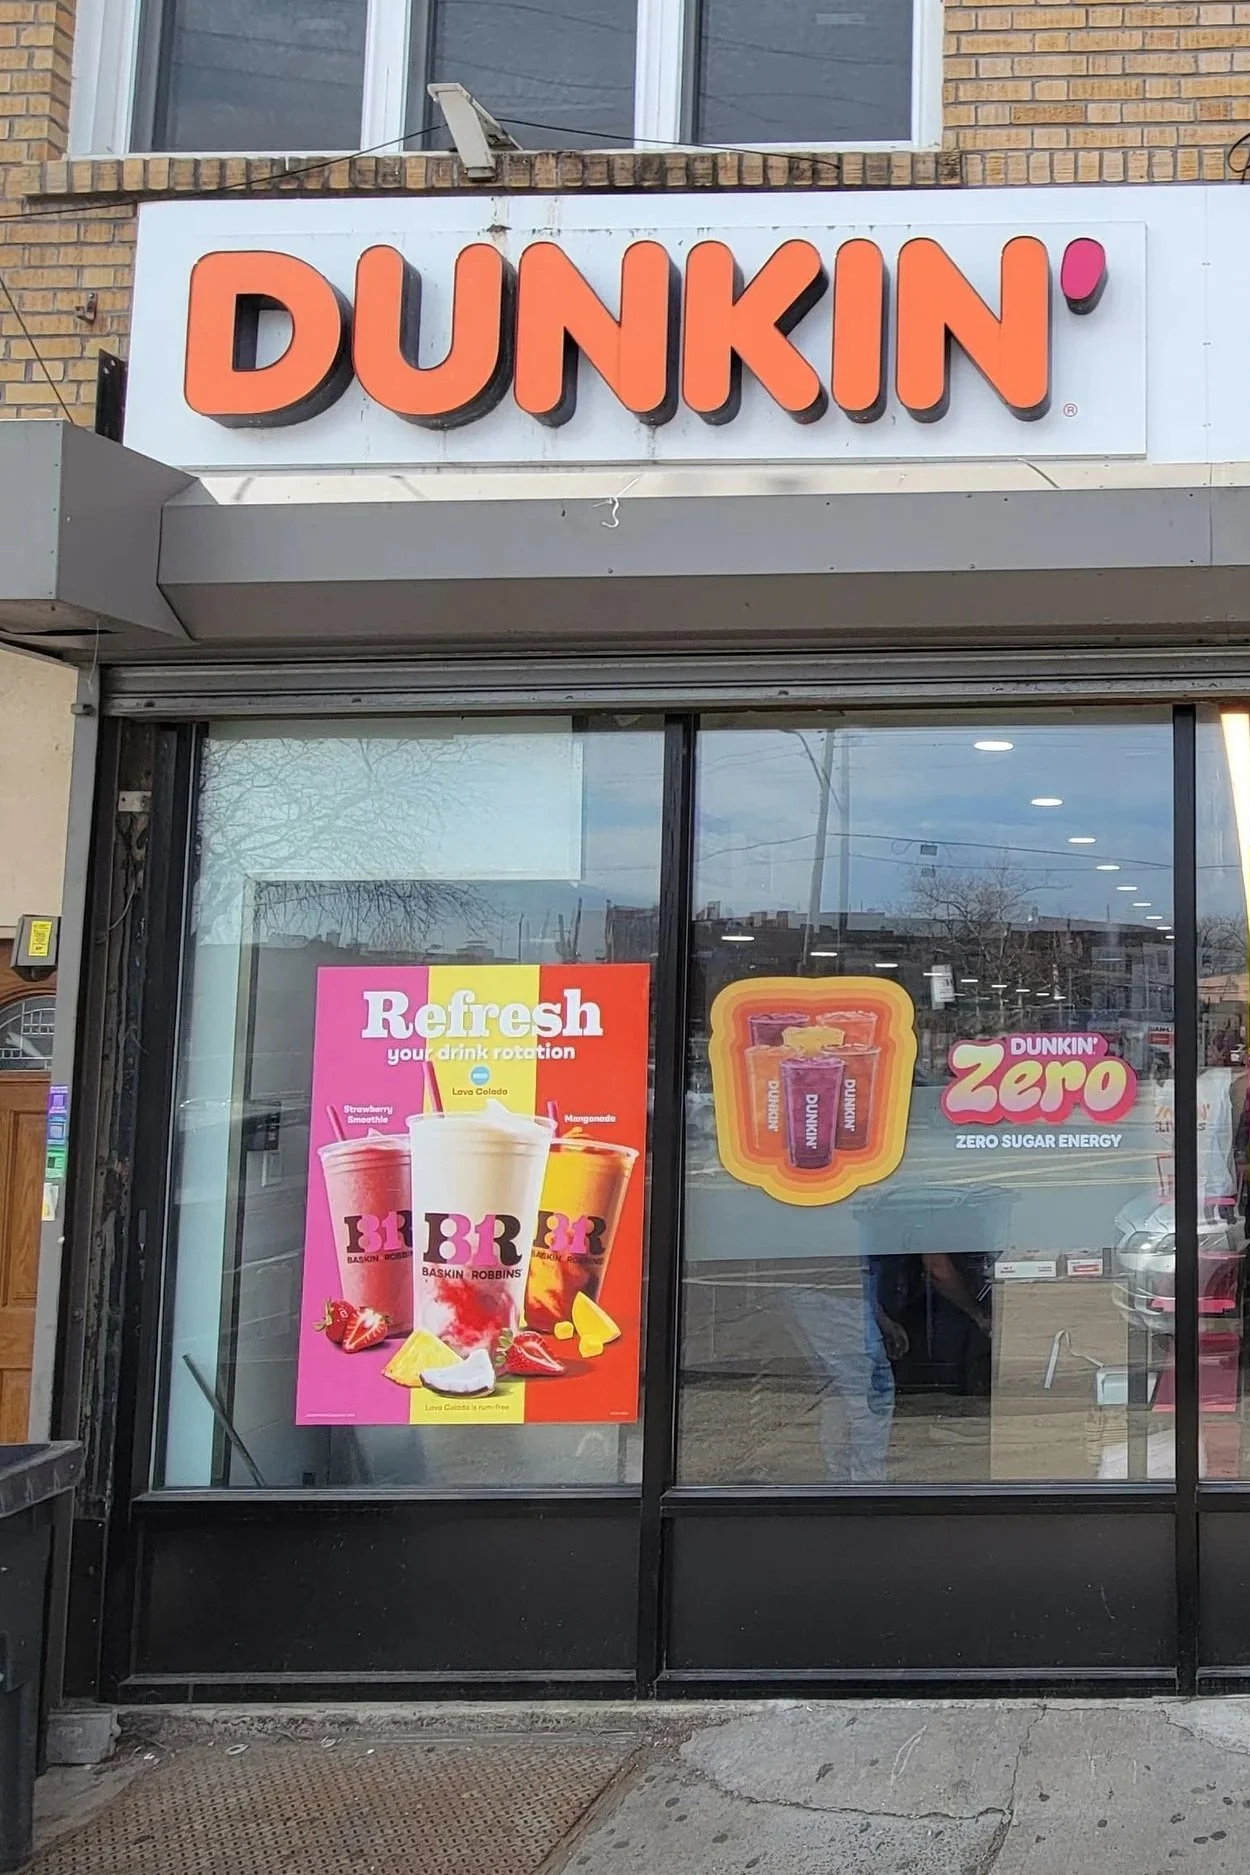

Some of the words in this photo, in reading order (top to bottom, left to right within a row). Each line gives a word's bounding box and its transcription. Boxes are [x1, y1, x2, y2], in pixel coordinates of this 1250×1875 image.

[184, 236, 1106, 420] DUNKIN'
[361, 988, 603, 1039] Refresh
[387, 1047, 432, 1066] your
[438, 1043, 489, 1061] drink
[493, 1042, 576, 1061] rotation
[1010, 1037, 1098, 1056] DUNKIN'
[946, 1043, 1127, 1112] Zero
[452, 1087, 474, 1096] Lava
[475, 1087, 508, 1096] Colada
[344, 1105, 393, 1115] Strawberry
[768, 1080, 779, 1132] DUNKIN'
[845, 1079, 856, 1132] DUNKIN'
[347, 1115, 389, 1124] Smoothie
[564, 1114, 616, 1124] Mangonada
[806, 1094, 818, 1149] DUNKIN'
[955, 1135, 998, 1149] ZERO
[1001, 1135, 1056, 1149] SUGAR
[1058, 1134, 1122, 1148] ENERGY
[423, 1213, 523, 1267] BR
[347, 1255, 379, 1264] BASKIN
[422, 1267, 464, 1279] BASKIN
[471, 1268, 522, 1280] ROBBINS
[425, 1403, 442, 1411] Lava
[478, 1403, 510, 1411] rum-free
